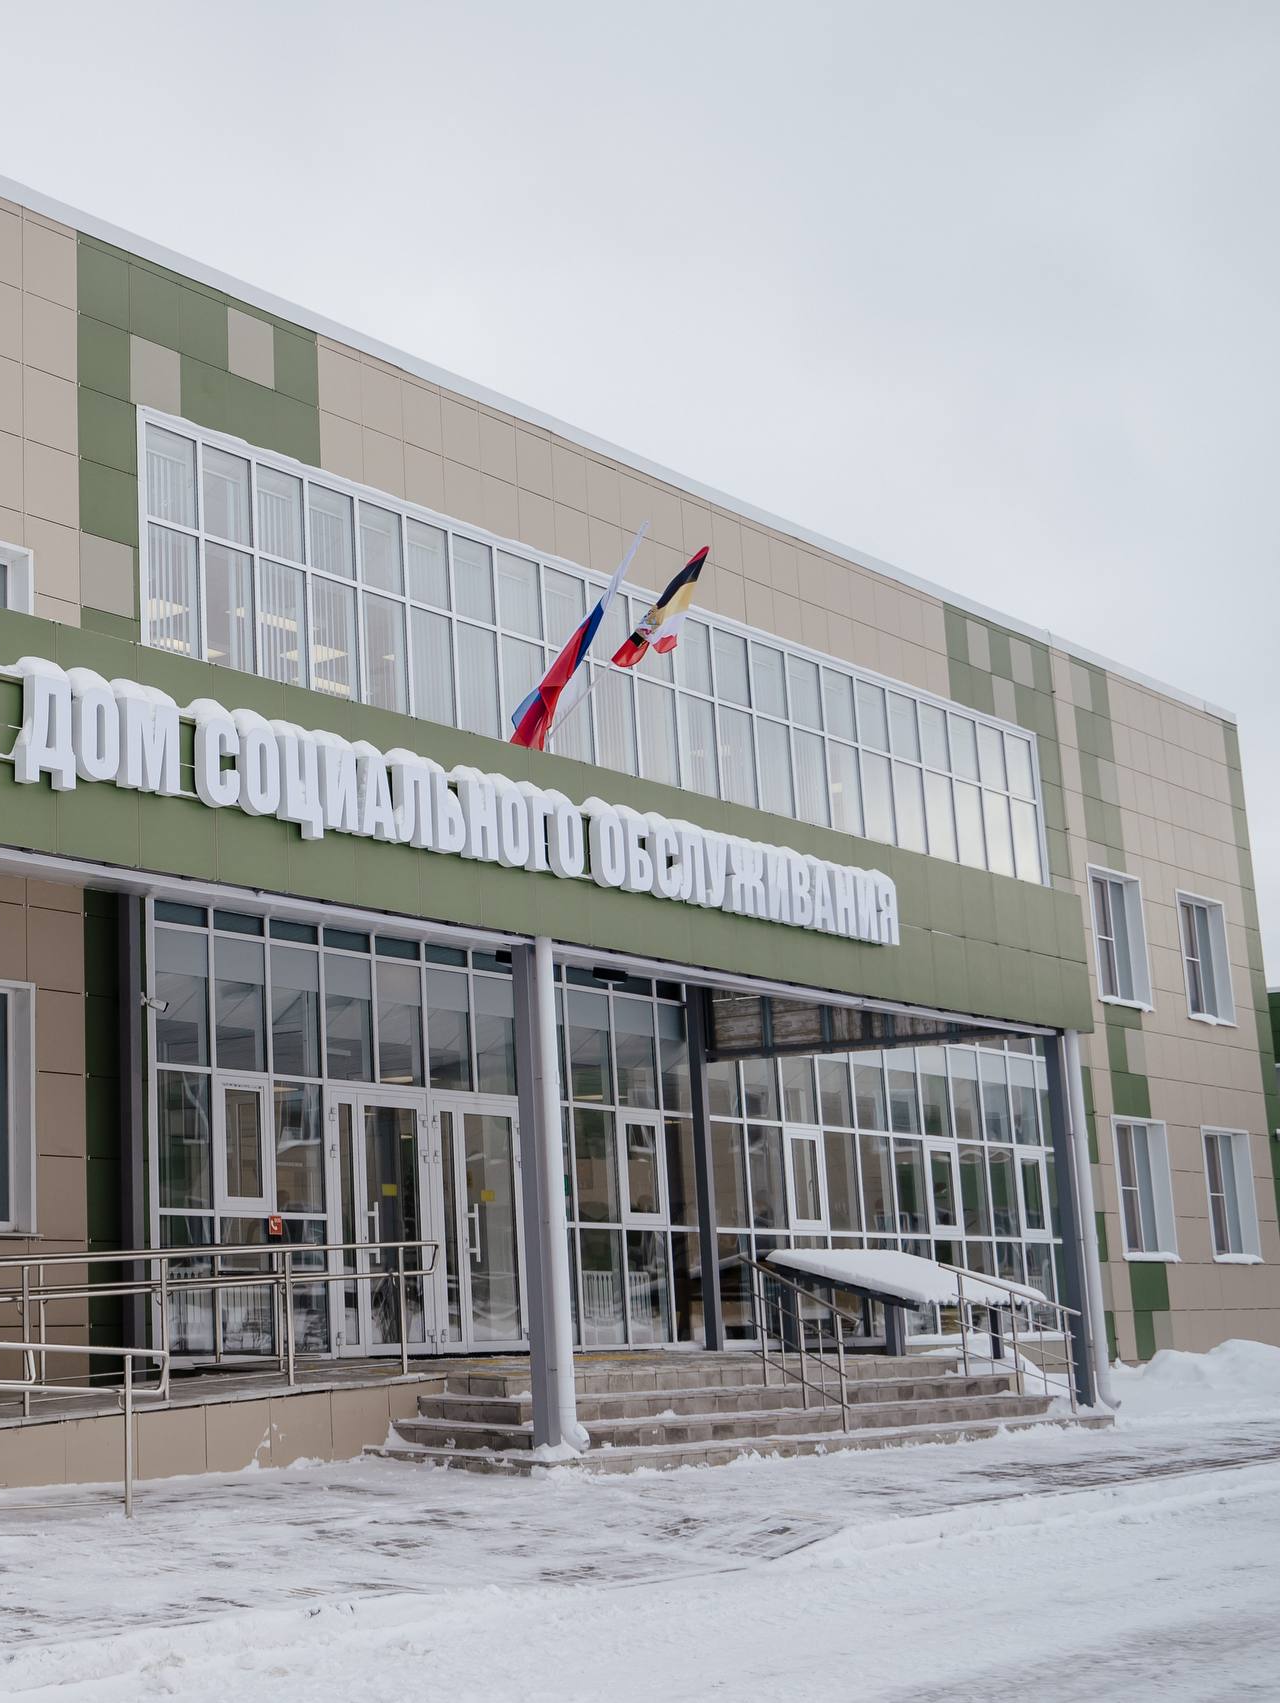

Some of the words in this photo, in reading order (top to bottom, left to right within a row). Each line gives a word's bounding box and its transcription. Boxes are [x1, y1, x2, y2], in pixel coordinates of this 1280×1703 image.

[15, 672, 180, 796] ДОМ
[194, 714, 586, 879] СОЦИАЛЬНОГО
[589, 813, 900, 946] ОБСЛУЖИВАНИЯ
